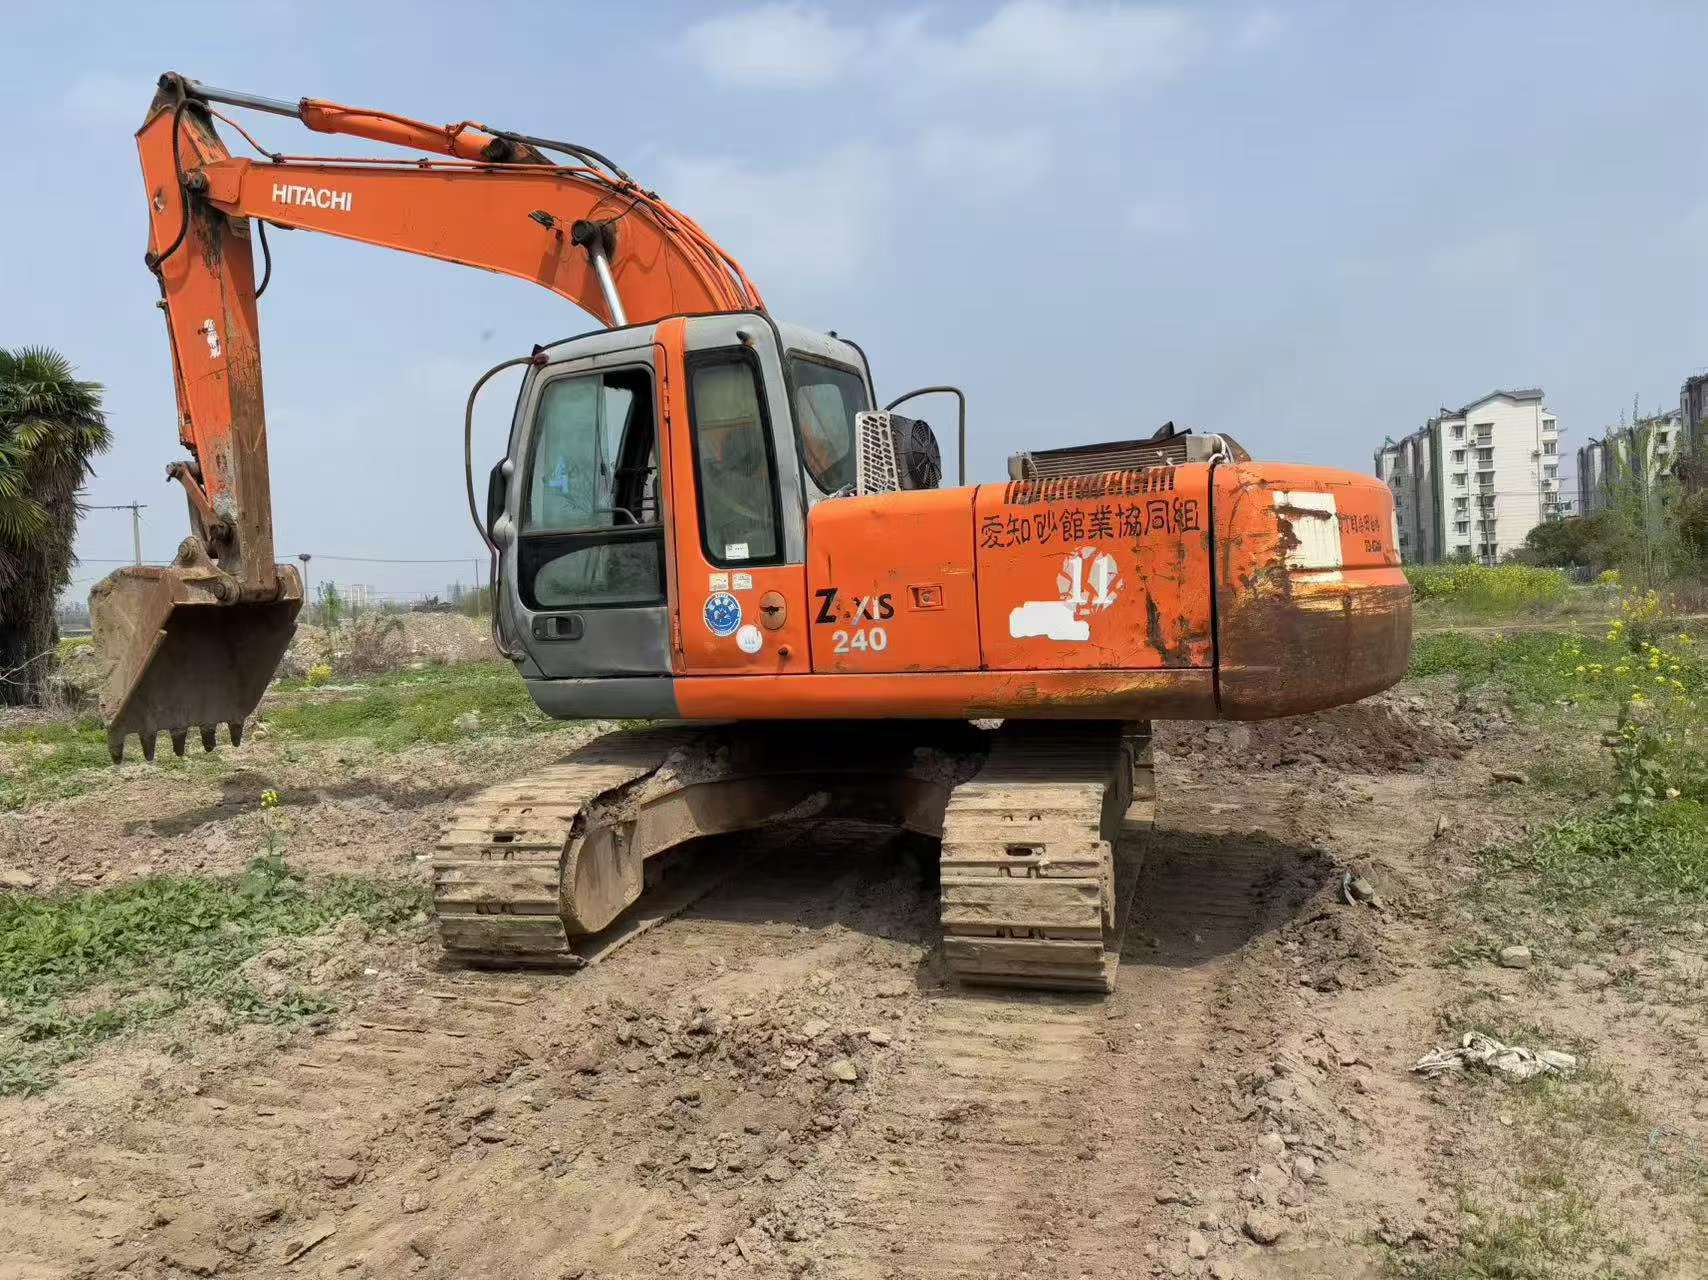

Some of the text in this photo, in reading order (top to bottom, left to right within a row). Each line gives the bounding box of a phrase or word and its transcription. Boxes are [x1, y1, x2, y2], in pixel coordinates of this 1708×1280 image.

[271, 183, 352, 212] HITACHI
[815, 587, 895, 625] ZXIS
[832, 626, 888, 653] 240
